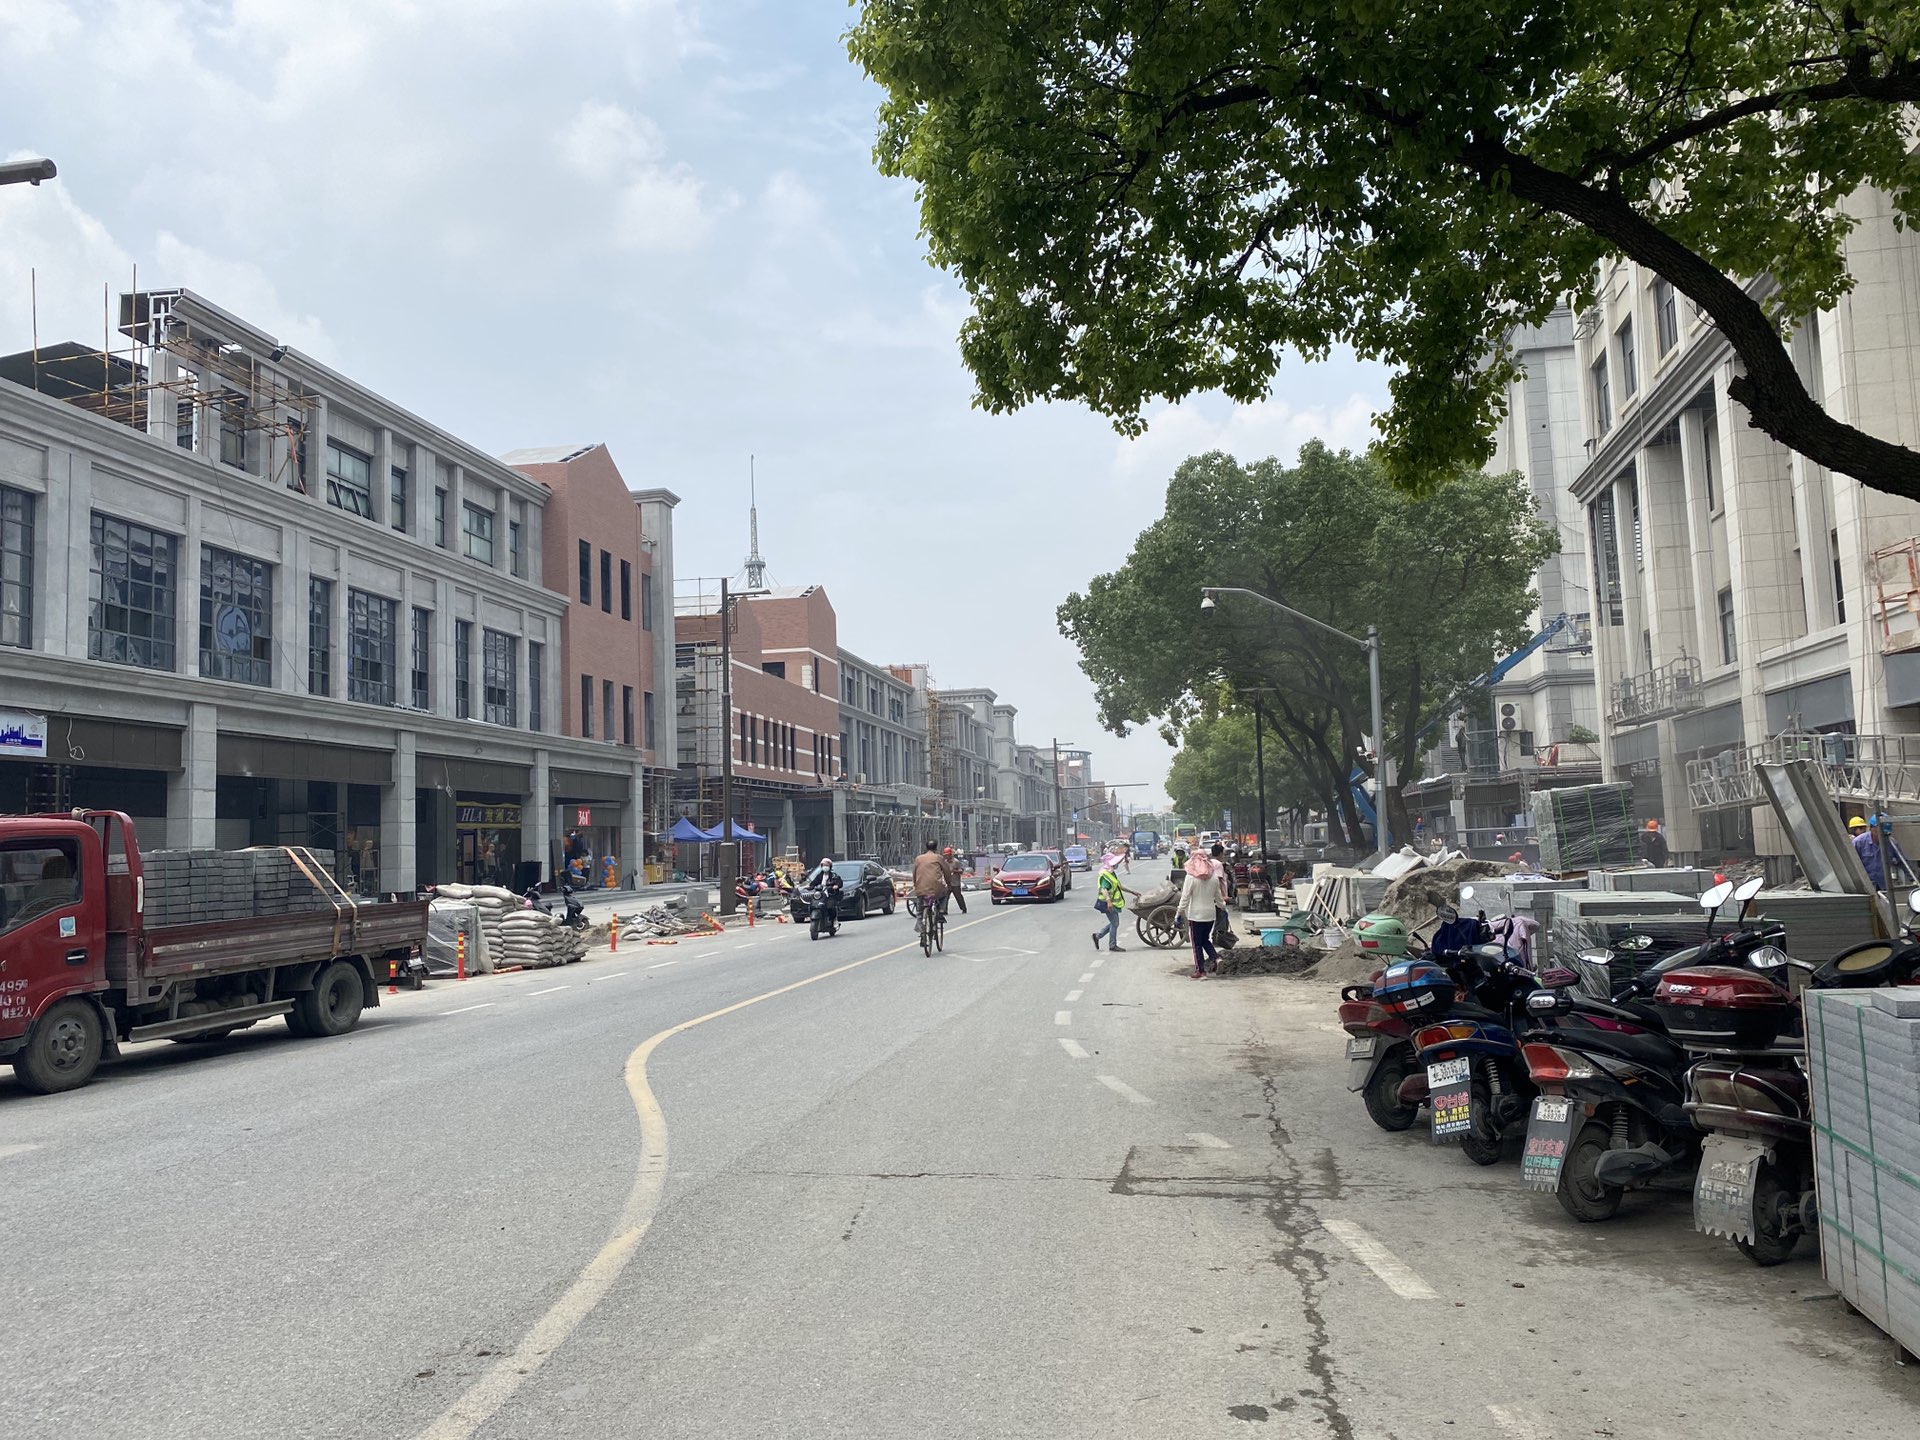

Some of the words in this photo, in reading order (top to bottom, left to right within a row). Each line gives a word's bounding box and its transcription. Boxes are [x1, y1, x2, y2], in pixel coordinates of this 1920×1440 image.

[461, 808, 482, 822] HLA
[1525, 1156, 1561, 1168] 以旧换新
